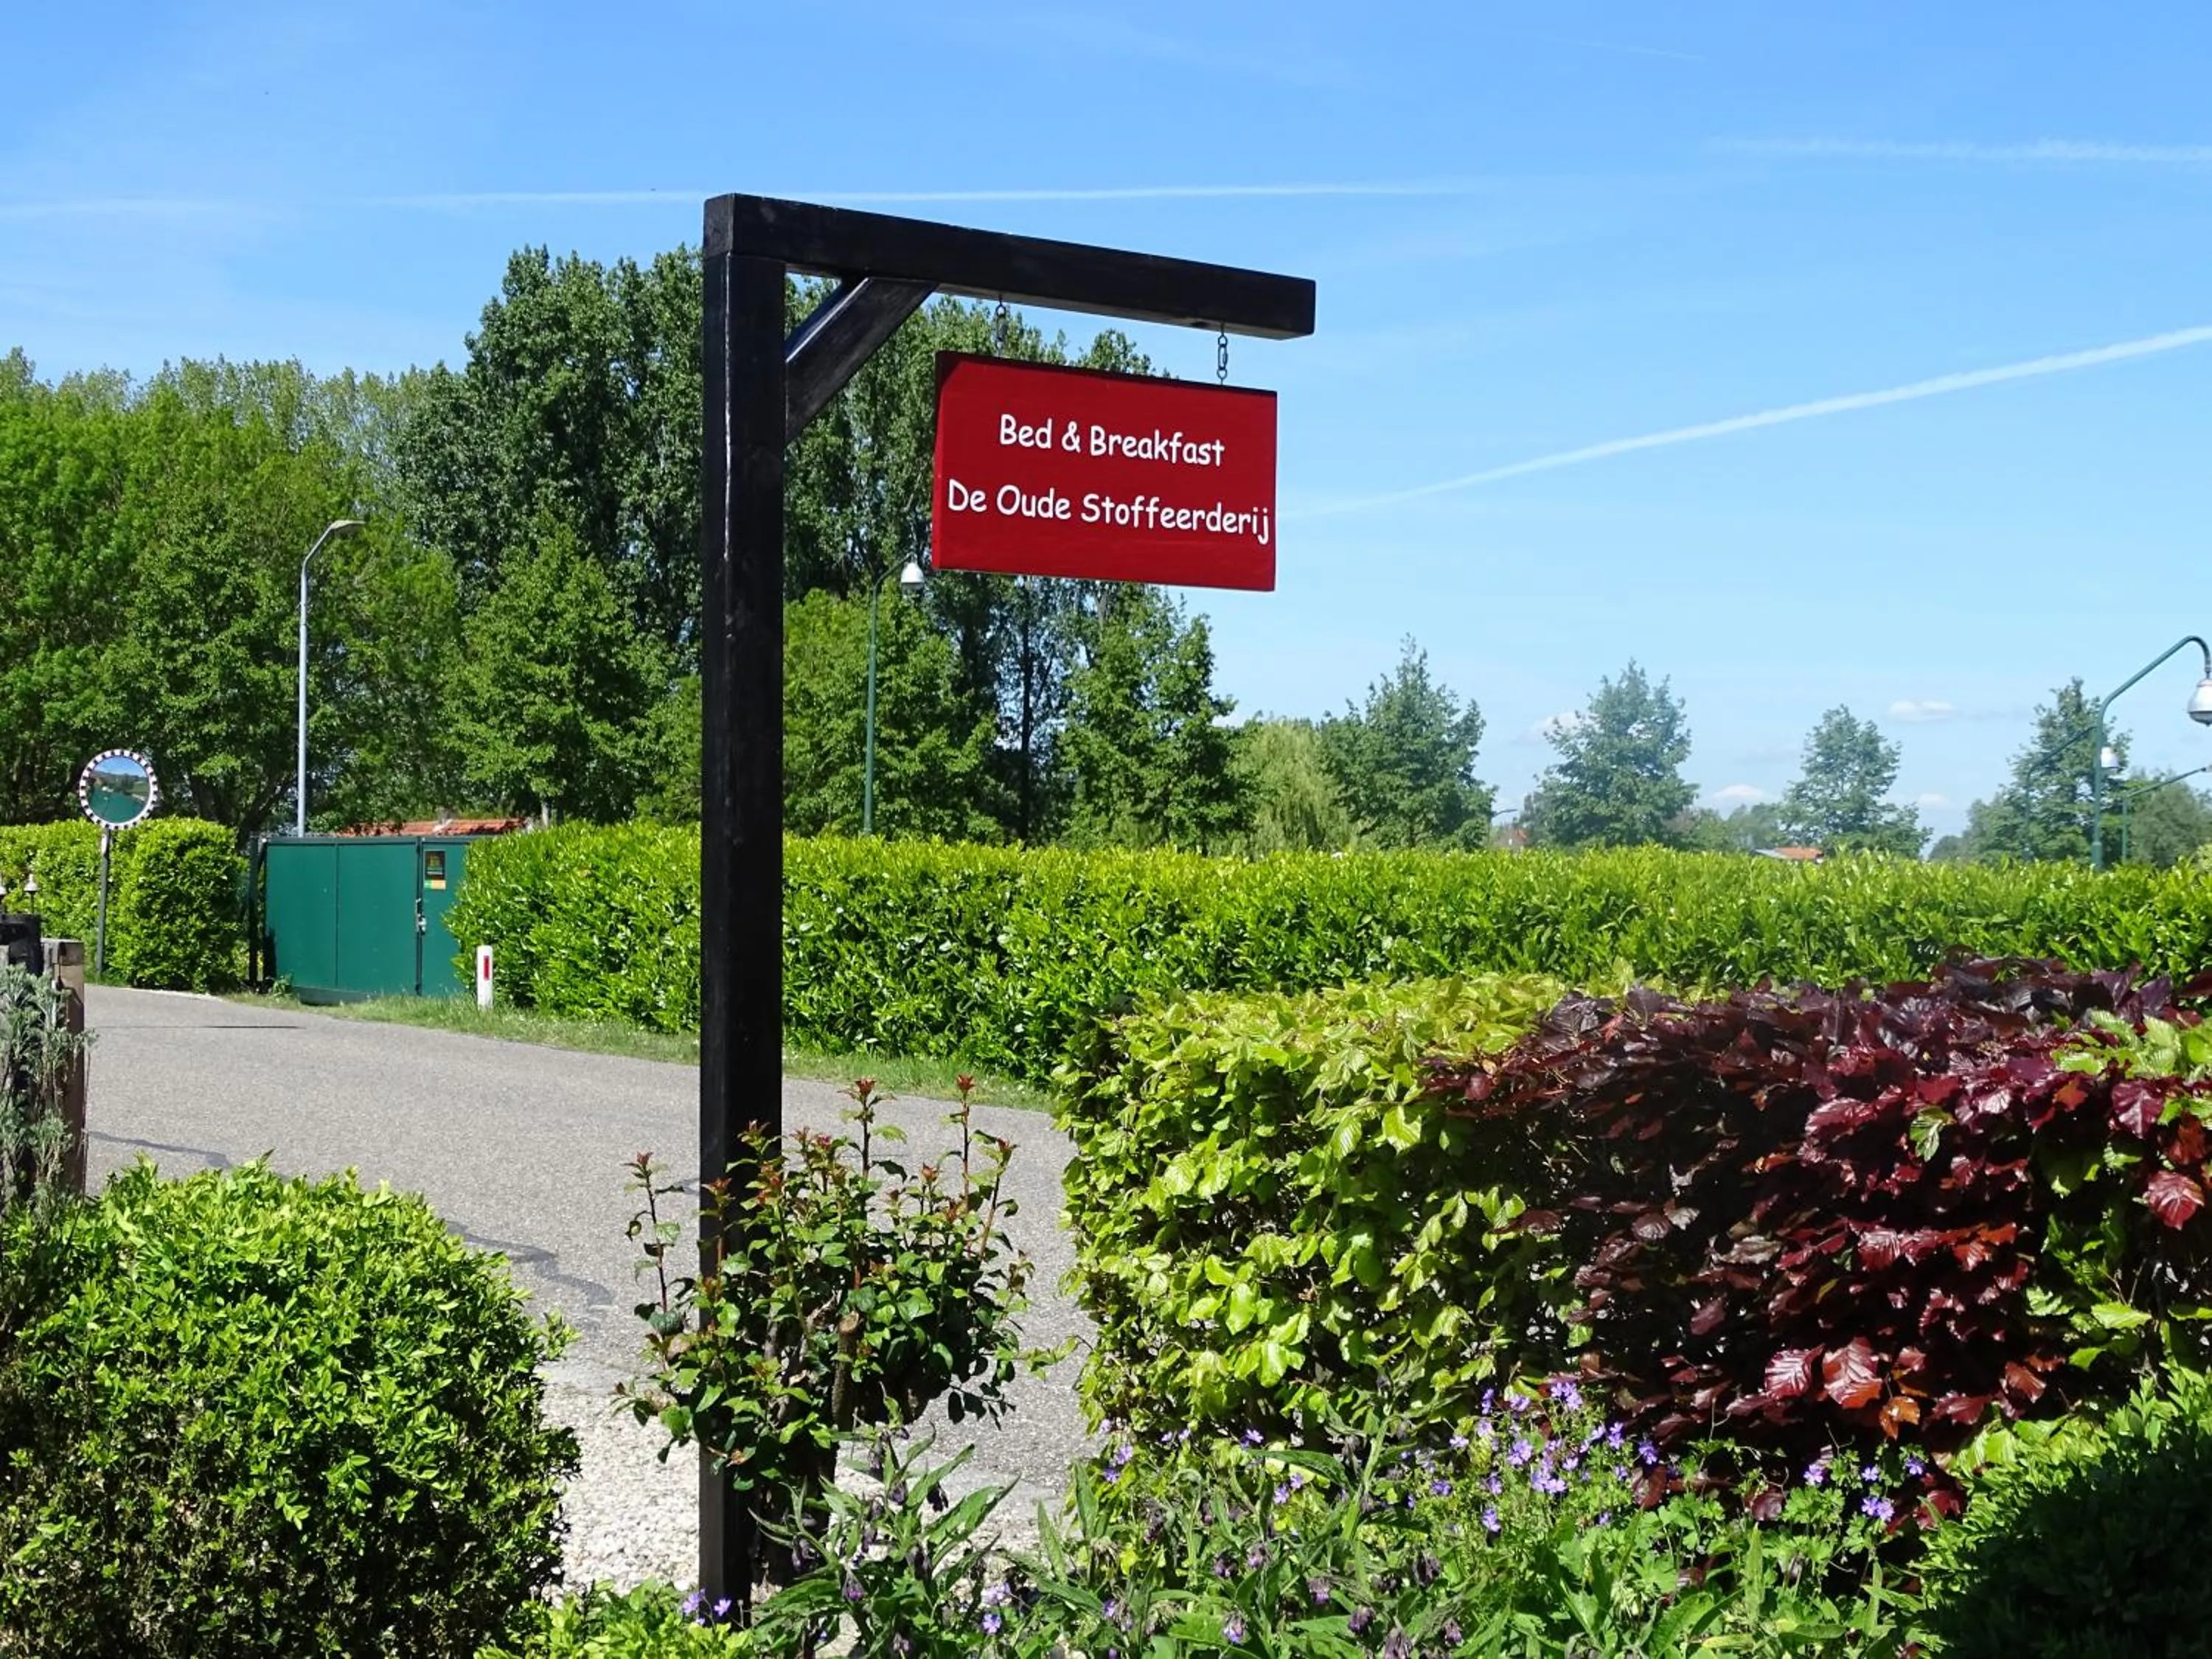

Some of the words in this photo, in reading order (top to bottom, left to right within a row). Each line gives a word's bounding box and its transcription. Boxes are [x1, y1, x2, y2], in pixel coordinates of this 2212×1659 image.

[999, 413, 1052, 449] Bed
[1060, 421, 1082, 453] &
[1089, 424, 1225, 467] Breakfast
[947, 479, 988, 512] De
[995, 484, 1072, 520] Oude
[1080, 493, 1270, 546] Stoffeerderij
